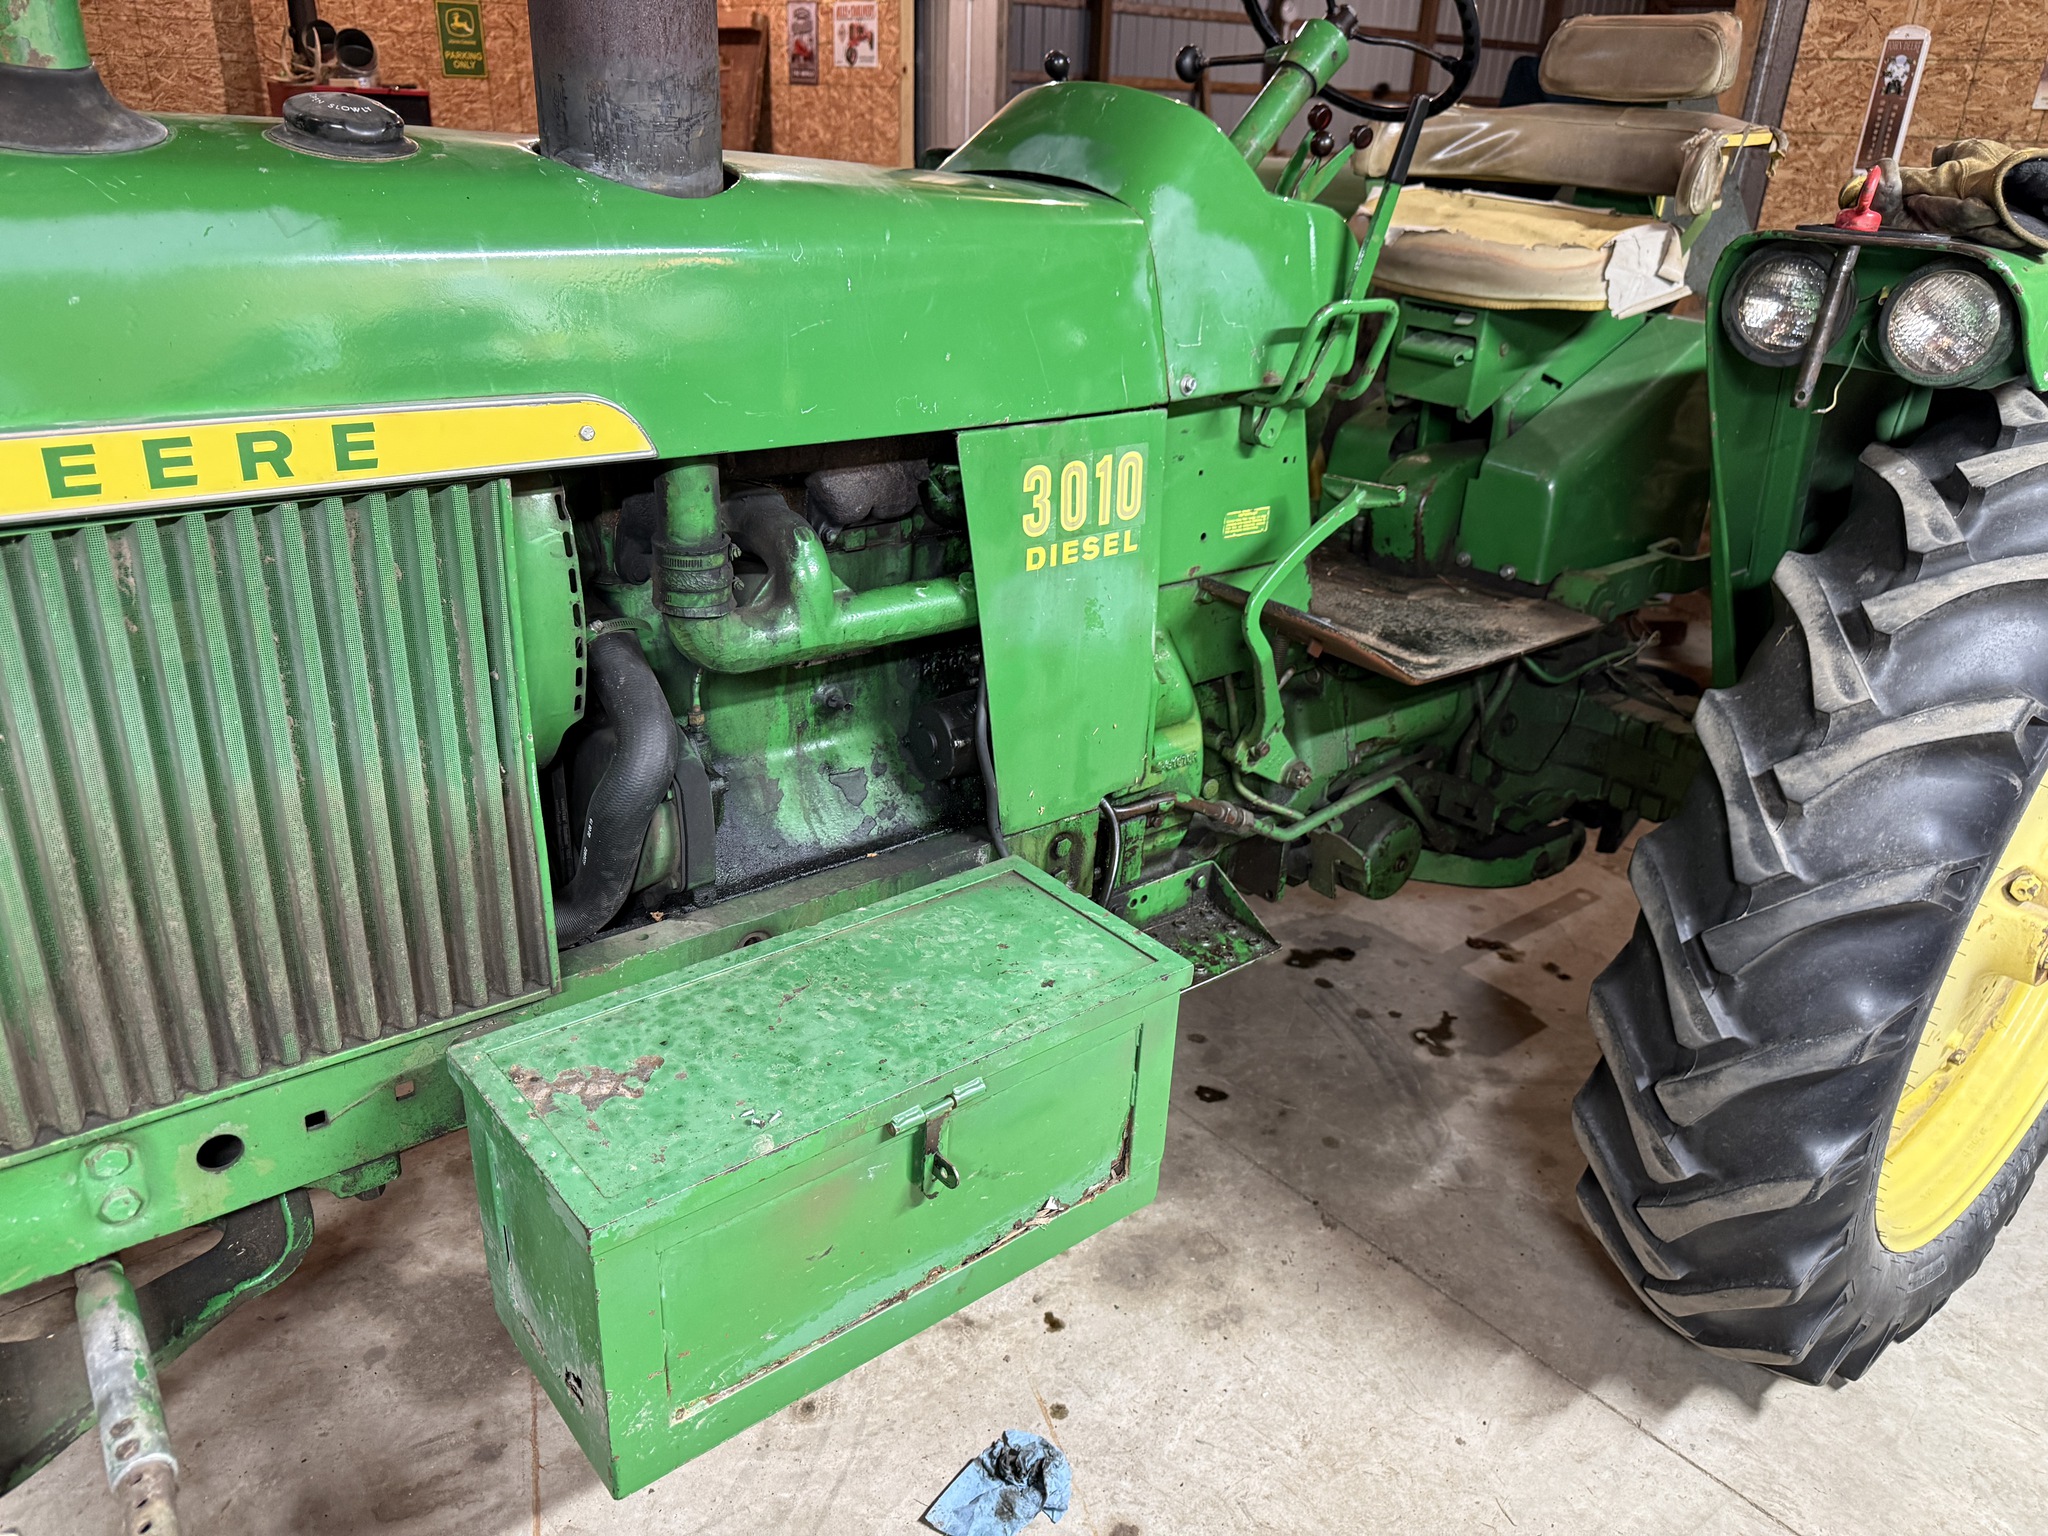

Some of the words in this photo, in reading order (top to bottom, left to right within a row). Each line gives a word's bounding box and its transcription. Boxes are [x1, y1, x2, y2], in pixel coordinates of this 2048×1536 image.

[445, 50, 483, 61] PARKING
[453, 60, 476, 69] ONLY
[327, 103, 372, 113] SLOWLY
[41, 422, 379, 499] EERE
[1022, 450, 1143, 538] 3010
[1026, 529, 1138, 572] DIESEL
